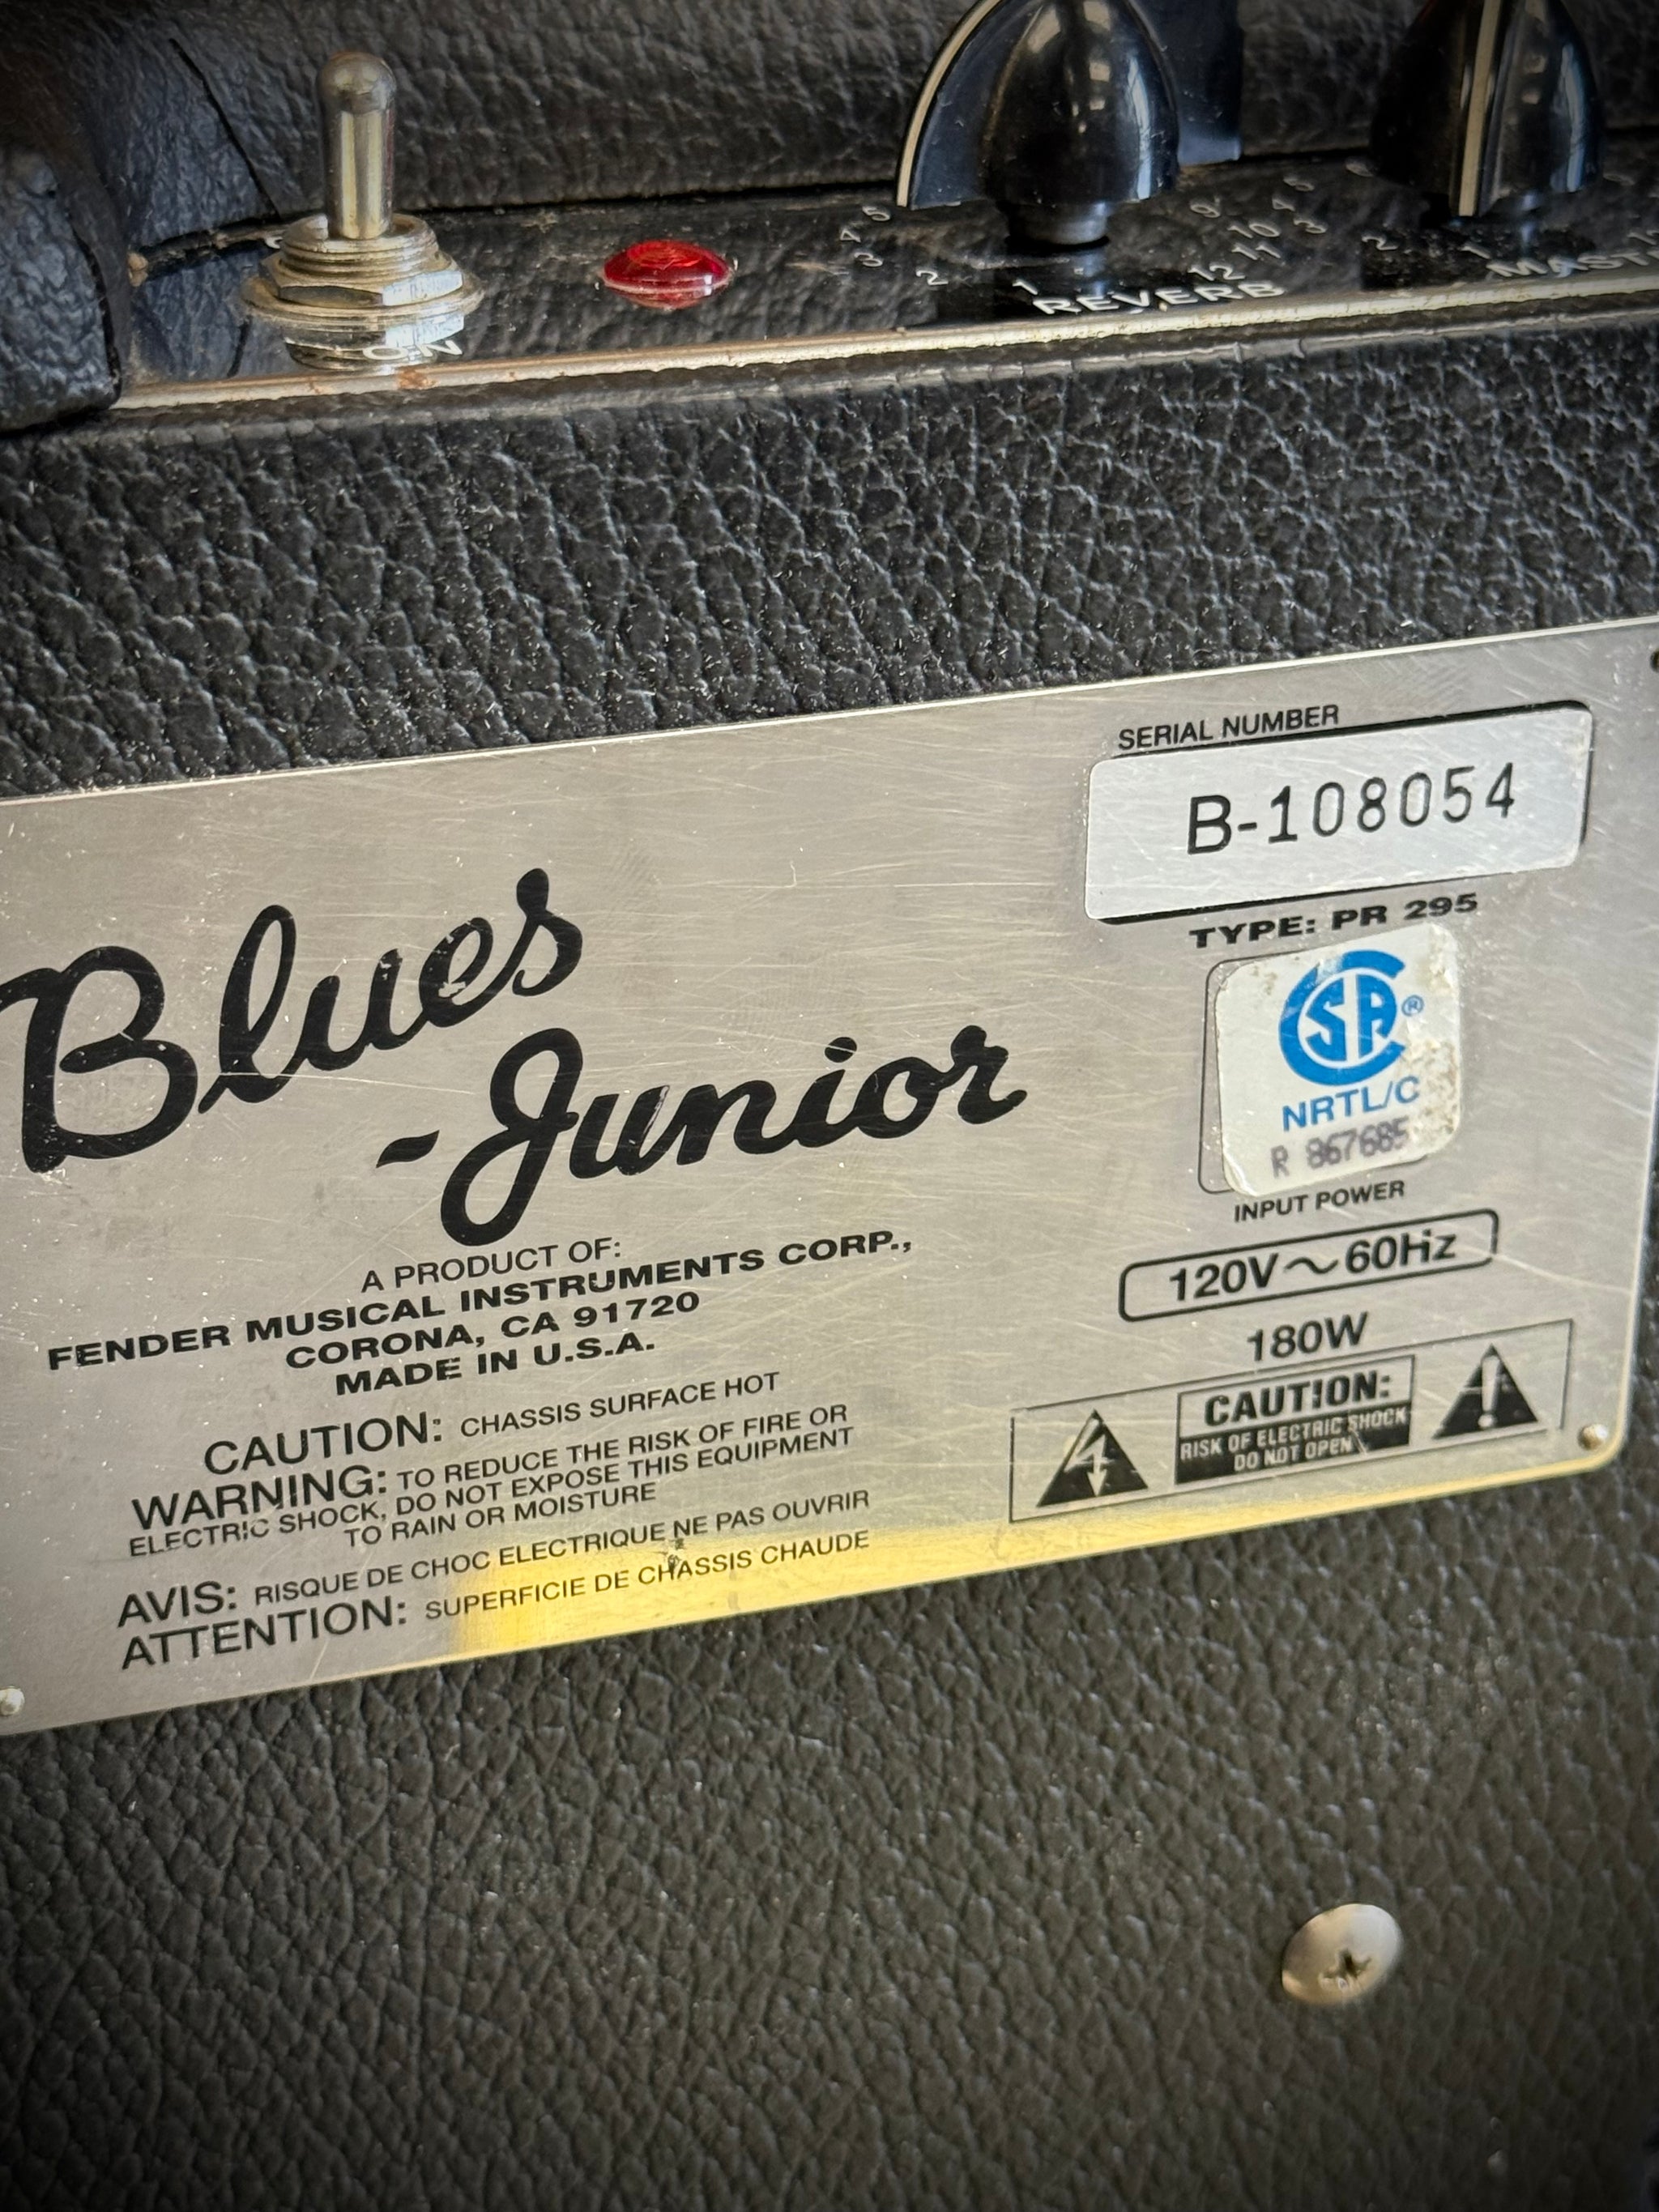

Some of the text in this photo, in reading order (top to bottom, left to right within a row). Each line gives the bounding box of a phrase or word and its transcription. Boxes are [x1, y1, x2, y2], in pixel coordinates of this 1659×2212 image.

[840, 227, 861, 243] 4
[862, 206, 890, 221] 5
[1227, 221, 1281, 238] 10
[1294, 218, 1328, 234] 3
[854, 251, 883, 267] 3
[1231, 244, 1281, 260] 11
[1361, 235, 1399, 250] 2
[915, 270, 949, 285] 2
[1013, 279, 1038, 296] 1
[1188, 263, 1246, 281] 12
[1033, 283, 1286, 314] REVERB
[363, 340, 463, 360] ON
[1118, 704, 1340, 751] SERIAL NUMBER
[1188, 761, 1516, 856] B-108054
[1188, 893, 1478, 948] TYPE: PR 295
[0, 867, 583, 1173] Blues
[1282, 1076, 1420, 1132] NRTL/C
[376, 1025, 1028, 1247] Junior
[1270, 1144, 1290, 1178] R
[1234, 1179, 1405, 1222] INPUT POWER
[361, 1237, 621, 1294] A PRODUCT OF:
[48, 1230, 912, 1370] FENDER MUSICAL INSTRUMENTS CORP.,
[286, 1291, 700, 1369] CORONA, CA 91720
[1247, 1312, 1370, 1362] 180W
[335, 1332, 655, 1396] MADE IN U.S.A.
[204, 1371, 780, 1475] CAUTION: CHASSIS SURFACE HOT
[1204, 1370, 1391, 1427] CAUTION:
[1179, 1405, 1408, 1461] RISK OF ELECTRIC SHOCK
[1233, 1435, 1353, 1473] DO NOT OPEN
[130, 1426, 855, 1558] ELECTRIC SHOCK, DO NOT EXPOSE THIS EQUIPMENT
[131, 1403, 848, 1531] WARNING: TO REDUCE THE RISK OF FIRE OR
[344, 1482, 657, 1549] TO RAIN OR MOISTURE
[117, 1488, 870, 1628] AVIS: RISQUE DE CHOC ELECTRIQUE NE PAS OUVRIR
[122, 1529, 871, 1671] ATTENTION: SUPERFICIE DE CHASSIS CHAUDE
